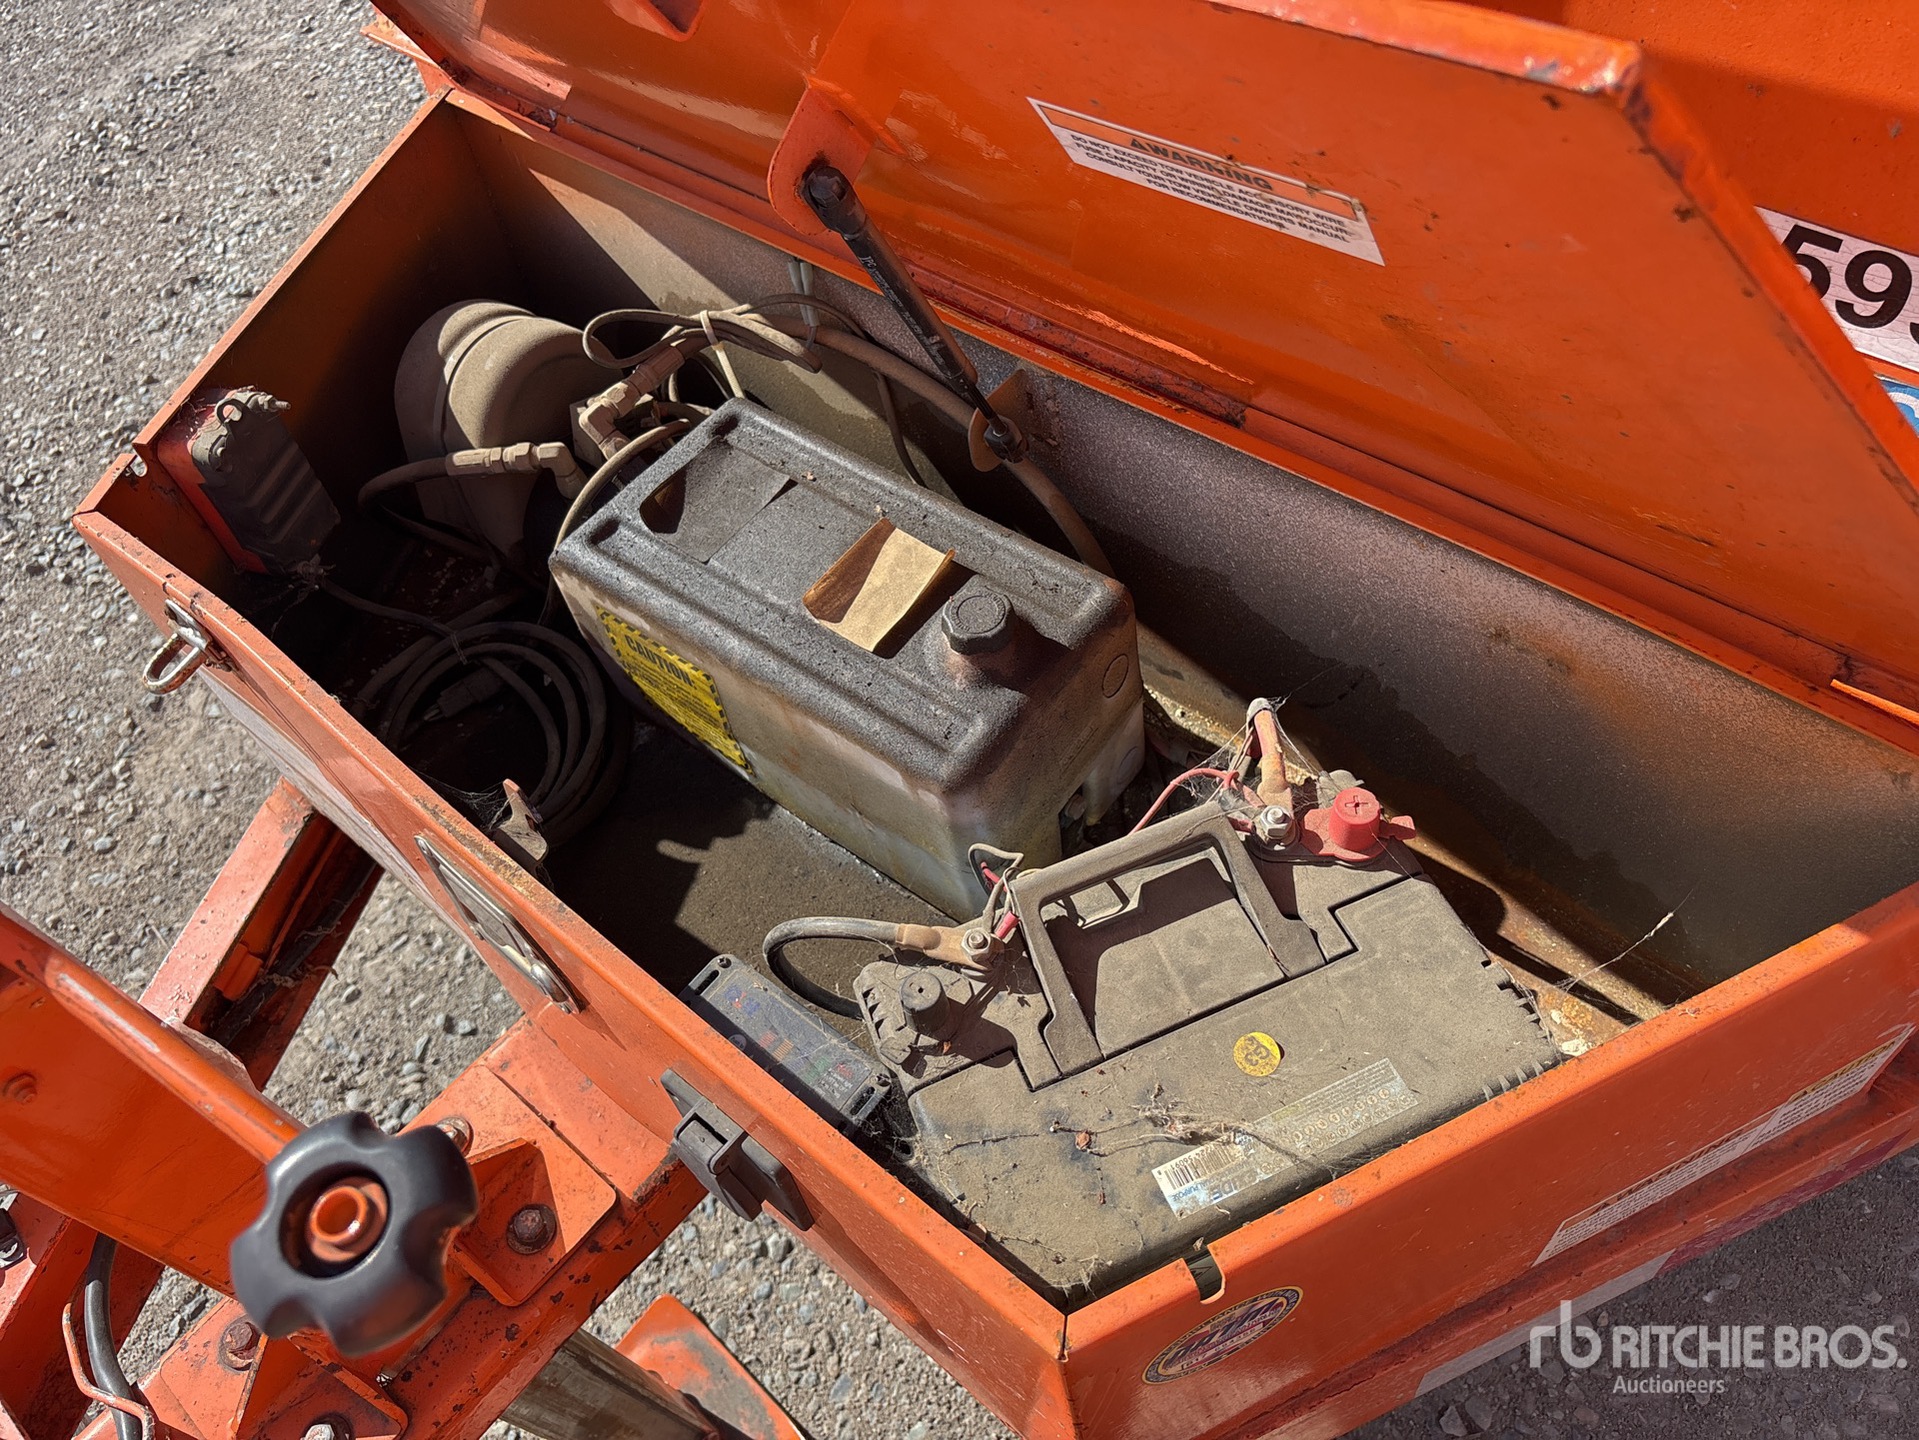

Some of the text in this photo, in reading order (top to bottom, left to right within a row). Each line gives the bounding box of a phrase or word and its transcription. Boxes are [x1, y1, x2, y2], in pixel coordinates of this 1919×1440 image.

[1070, 134, 1087, 143] DO
[1088, 140, 1111, 151] NOT
[1112, 148, 1157, 166] EXCEED
[1158, 162, 1183, 174] TOW
[1184, 171, 1234, 191] VEHICLE
[1312, 212, 1344, 227] WIRE
[1075, 142, 1104, 155] FUSE
[1104, 151, 1158, 173] CAPACITY
[1159, 169, 1177, 179] OR
[1221, 190, 1272, 210] DAMAGE
[1275, 207, 1302, 220] MAY
[1085, 152, 1348, 242] CONSULT YOUR TOW VEHICLE OWNERS MANUAL
[1145, 178, 1170, 190] FOR
[1146, 142, 1273, 191] WARNING
[1781, 224, 1919, 345] 59
[1811, 1041, 1896, 1092] CAUTION
[1170, 1183, 1199, 1202] PURPOSE
[1616, 1128, 1745, 1201] WARNING
